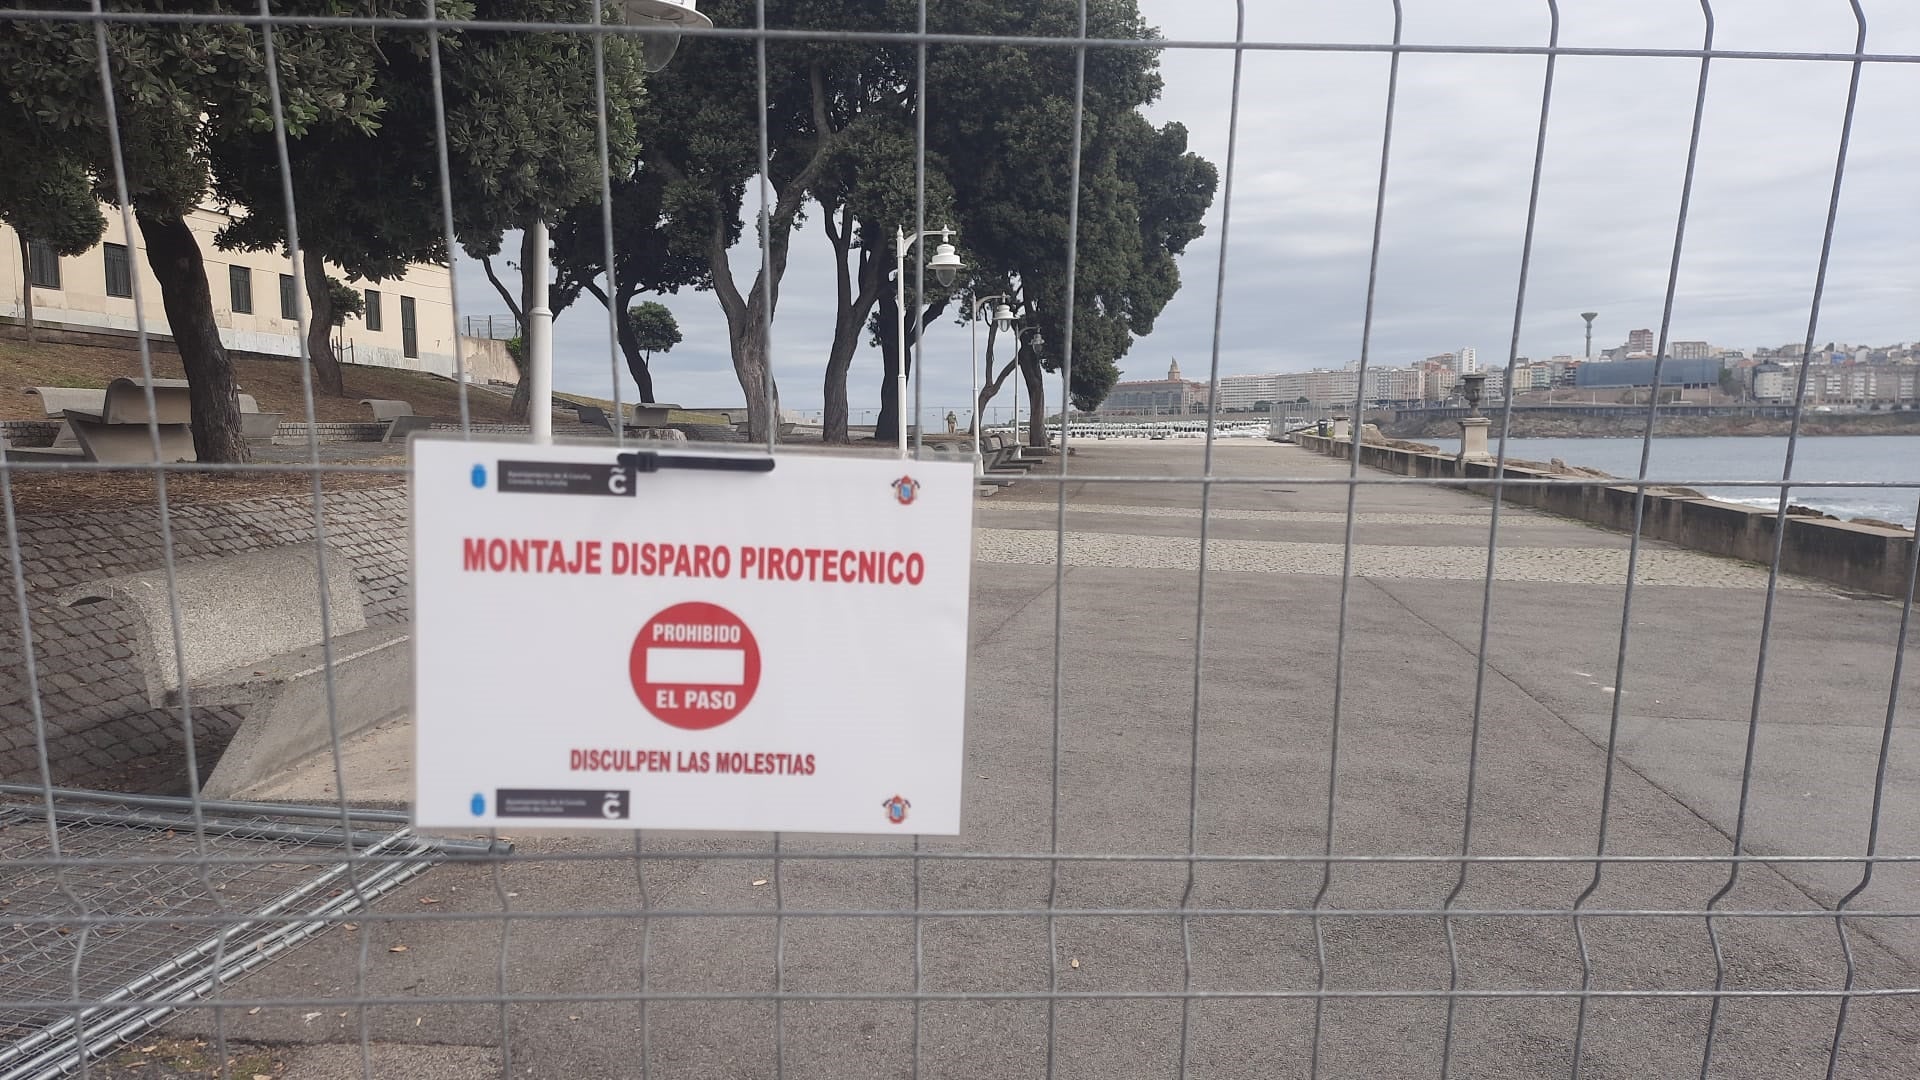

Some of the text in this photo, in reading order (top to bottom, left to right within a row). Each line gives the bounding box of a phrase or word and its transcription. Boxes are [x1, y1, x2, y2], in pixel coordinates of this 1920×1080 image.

[463, 538, 925, 586] MONTAJE DISPARO PIROTECNICO
[652, 623, 741, 643] PROHIBIDO
[656, 689, 736, 710] EL PASO
[571, 749, 816, 775] DISCULPEN LAS MOLESTIAS
